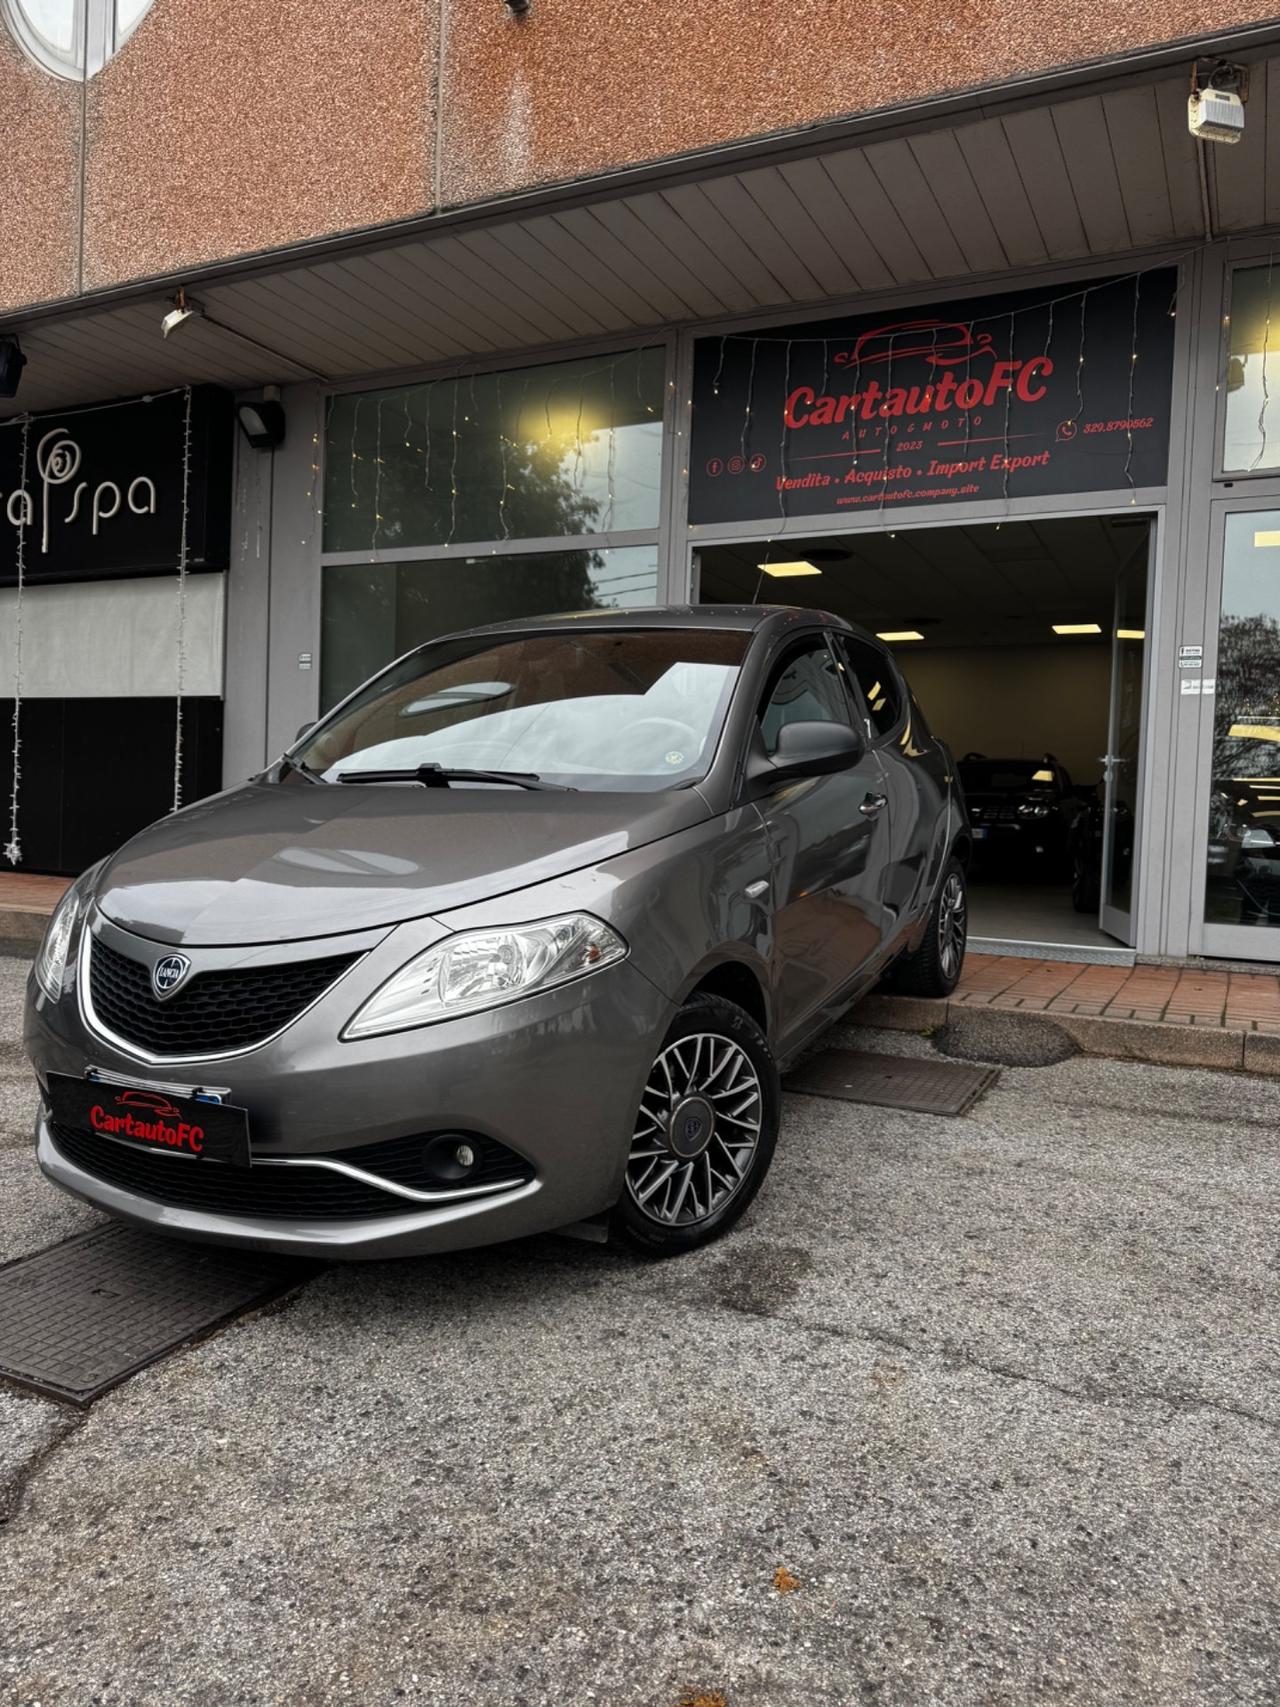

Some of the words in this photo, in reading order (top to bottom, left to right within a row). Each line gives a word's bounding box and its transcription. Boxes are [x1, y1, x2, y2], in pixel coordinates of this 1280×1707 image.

[784, 357, 1054, 429] CartautoFC
[895, 440, 924, 452] 2023
[775, 472, 831, 491] Vendita
[844, 464, 912, 486] Acquisto
[927, 457, 987, 479] Import
[989, 450, 1050, 472] Export
[89, 1105, 205, 1152] CartautoFC
